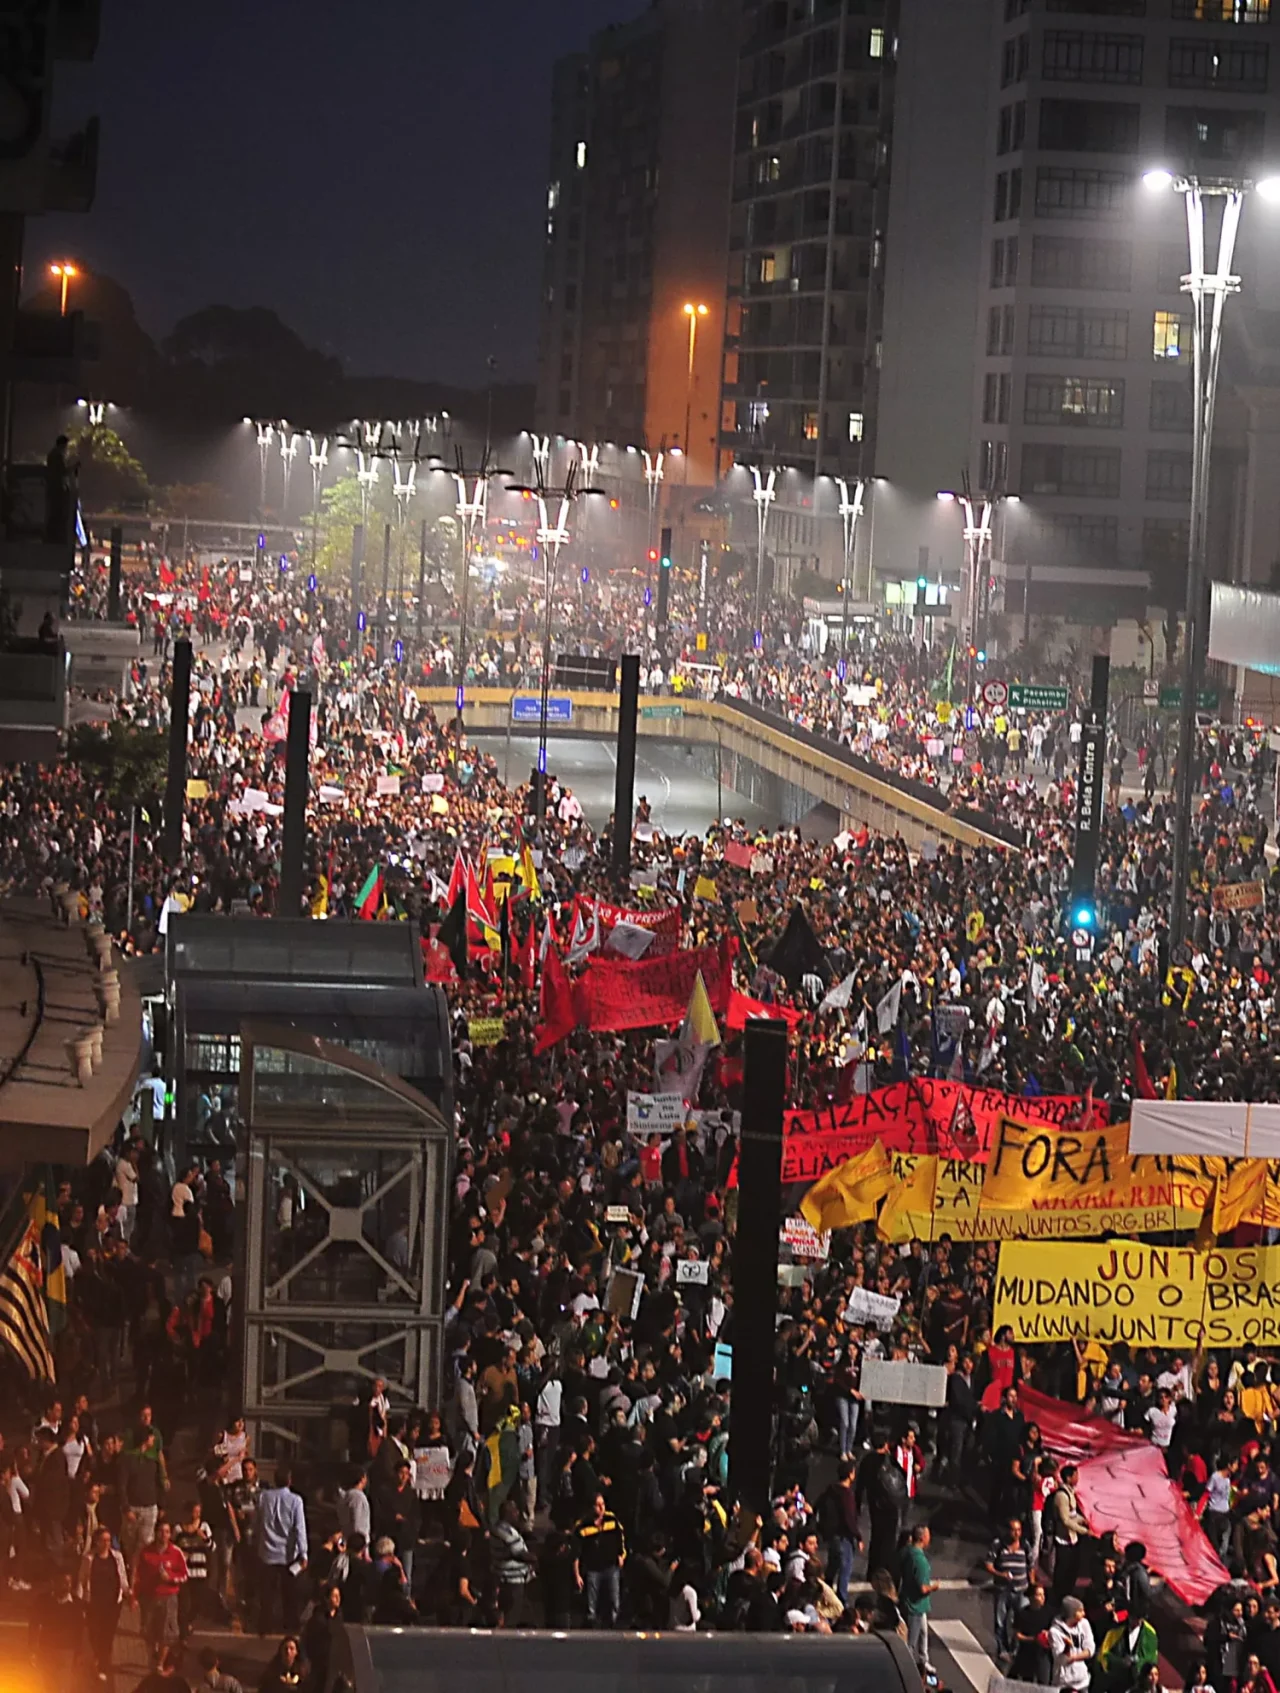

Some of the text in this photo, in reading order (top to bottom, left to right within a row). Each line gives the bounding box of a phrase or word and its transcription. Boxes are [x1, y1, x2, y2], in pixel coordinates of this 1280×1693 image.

[1083, 742, 1095, 784] Cintra
[1081, 786, 1093, 816] Bela
[788, 1081, 934, 1137] ATIZAÇÃO
[993, 1118, 1112, 1185] FORA
[1098, 1249, 1258, 1281] JUNTOS
[1000, 1275, 1134, 1307] MUDANDO
[1159, 1284, 1183, 1307] O
